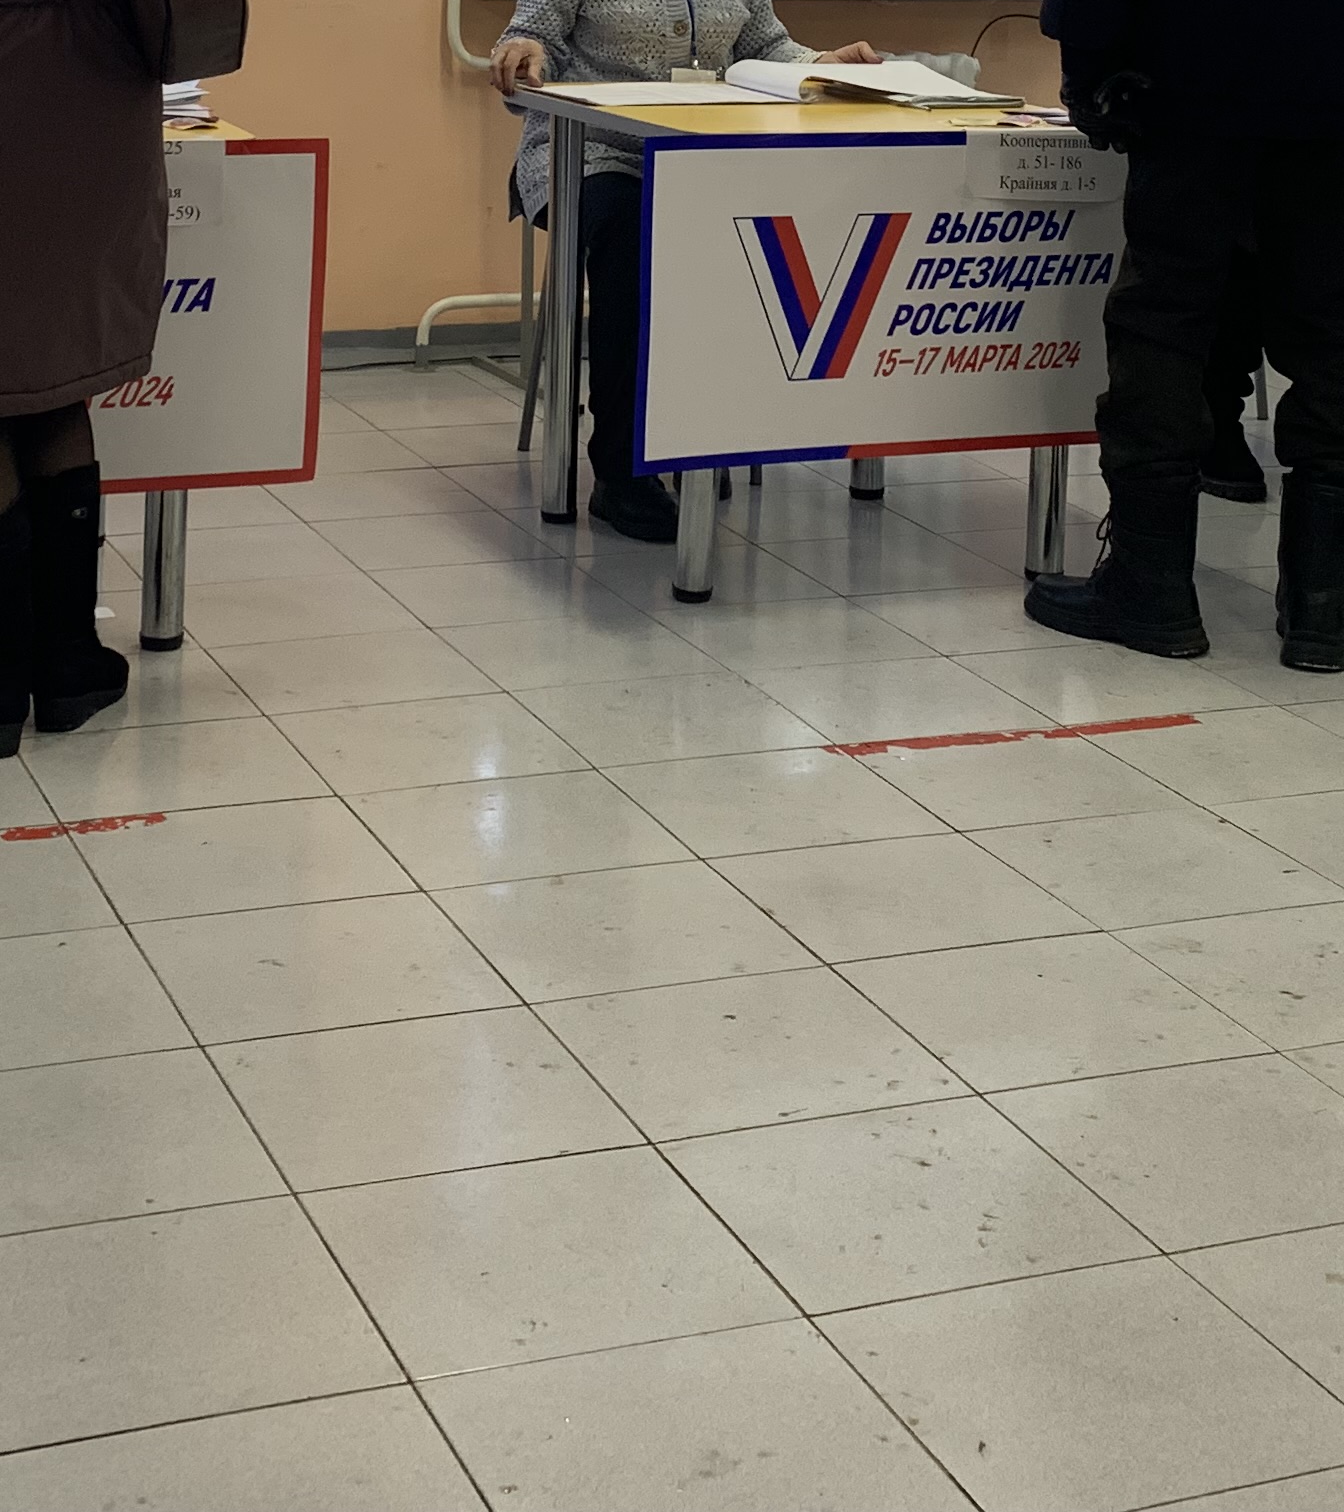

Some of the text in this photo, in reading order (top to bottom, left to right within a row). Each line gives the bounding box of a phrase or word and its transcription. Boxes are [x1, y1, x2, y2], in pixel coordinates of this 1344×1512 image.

[1016, 158, 1030, 170] д.
[1060, 156, 1082, 170] 186
[1000, 175, 1057, 193] Крайняя
[1078, 177, 1096, 191] 1-5
[924, 209, 1076, 245] ВЫБОРЫ
[905, 252, 1116, 293] ПРЕЗИДЕНТА
[886, 300, 1026, 338] РОССИИ
[873, 340, 1082, 378] 15–17 МАРТА 2024
